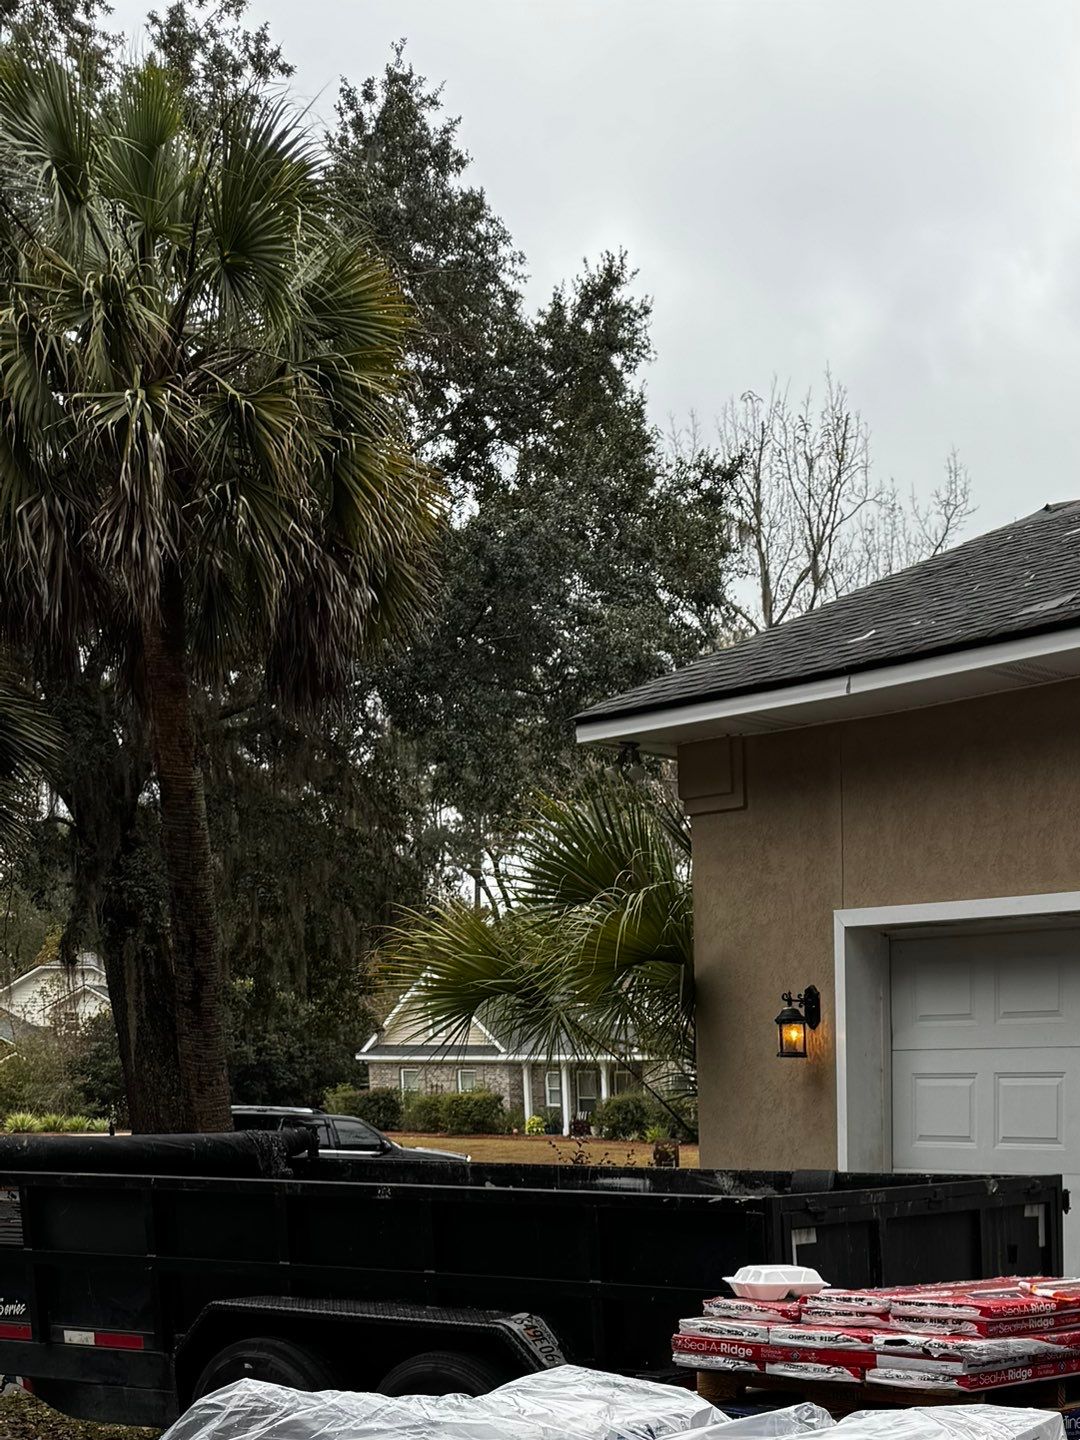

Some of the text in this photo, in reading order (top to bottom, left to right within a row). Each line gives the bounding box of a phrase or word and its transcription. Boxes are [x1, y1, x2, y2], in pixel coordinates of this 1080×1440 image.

[1002, 1301, 1056, 1317] Seal-A-Ridge
[998, 1317, 1055, 1334] Seal-A-Ridge
[683, 1337, 753, 1357] Seal-A-Ridge
[979, 1367, 1032, 1385] Seal-A-Ridge
